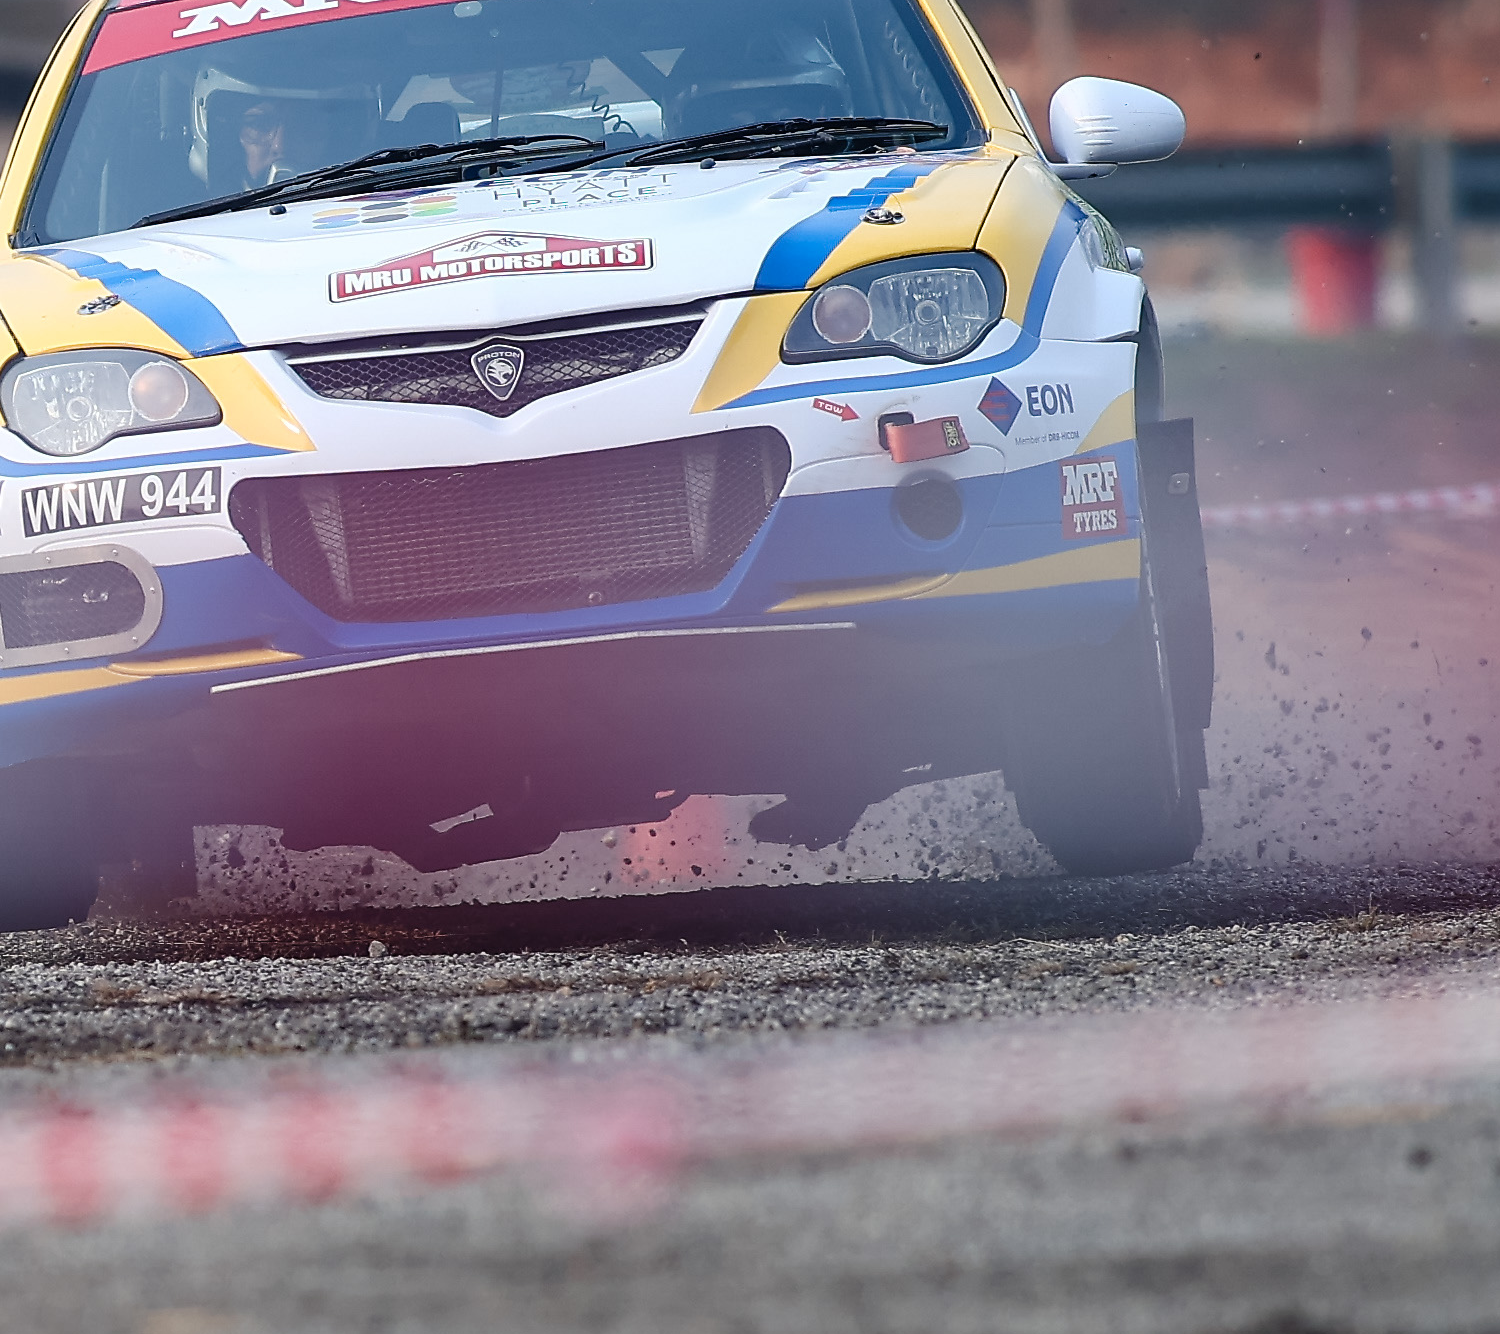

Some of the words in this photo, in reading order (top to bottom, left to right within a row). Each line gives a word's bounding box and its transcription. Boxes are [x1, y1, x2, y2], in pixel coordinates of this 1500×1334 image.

[494, 172, 678, 200] HYATT
[522, 186, 658, 208] PLACE
[344, 267, 412, 295] MRU
[420, 242, 638, 281] MOTORSPORTS
[477, 351, 521, 363] PROTON
[818, 400, 844, 414] TOW
[1026, 383, 1075, 417] EON
[1061, 461, 1118, 506] MRF
[25, 478, 126, 533] WNW
[140, 470, 216, 517] 944
[1073, 509, 1118, 533] TYRES
